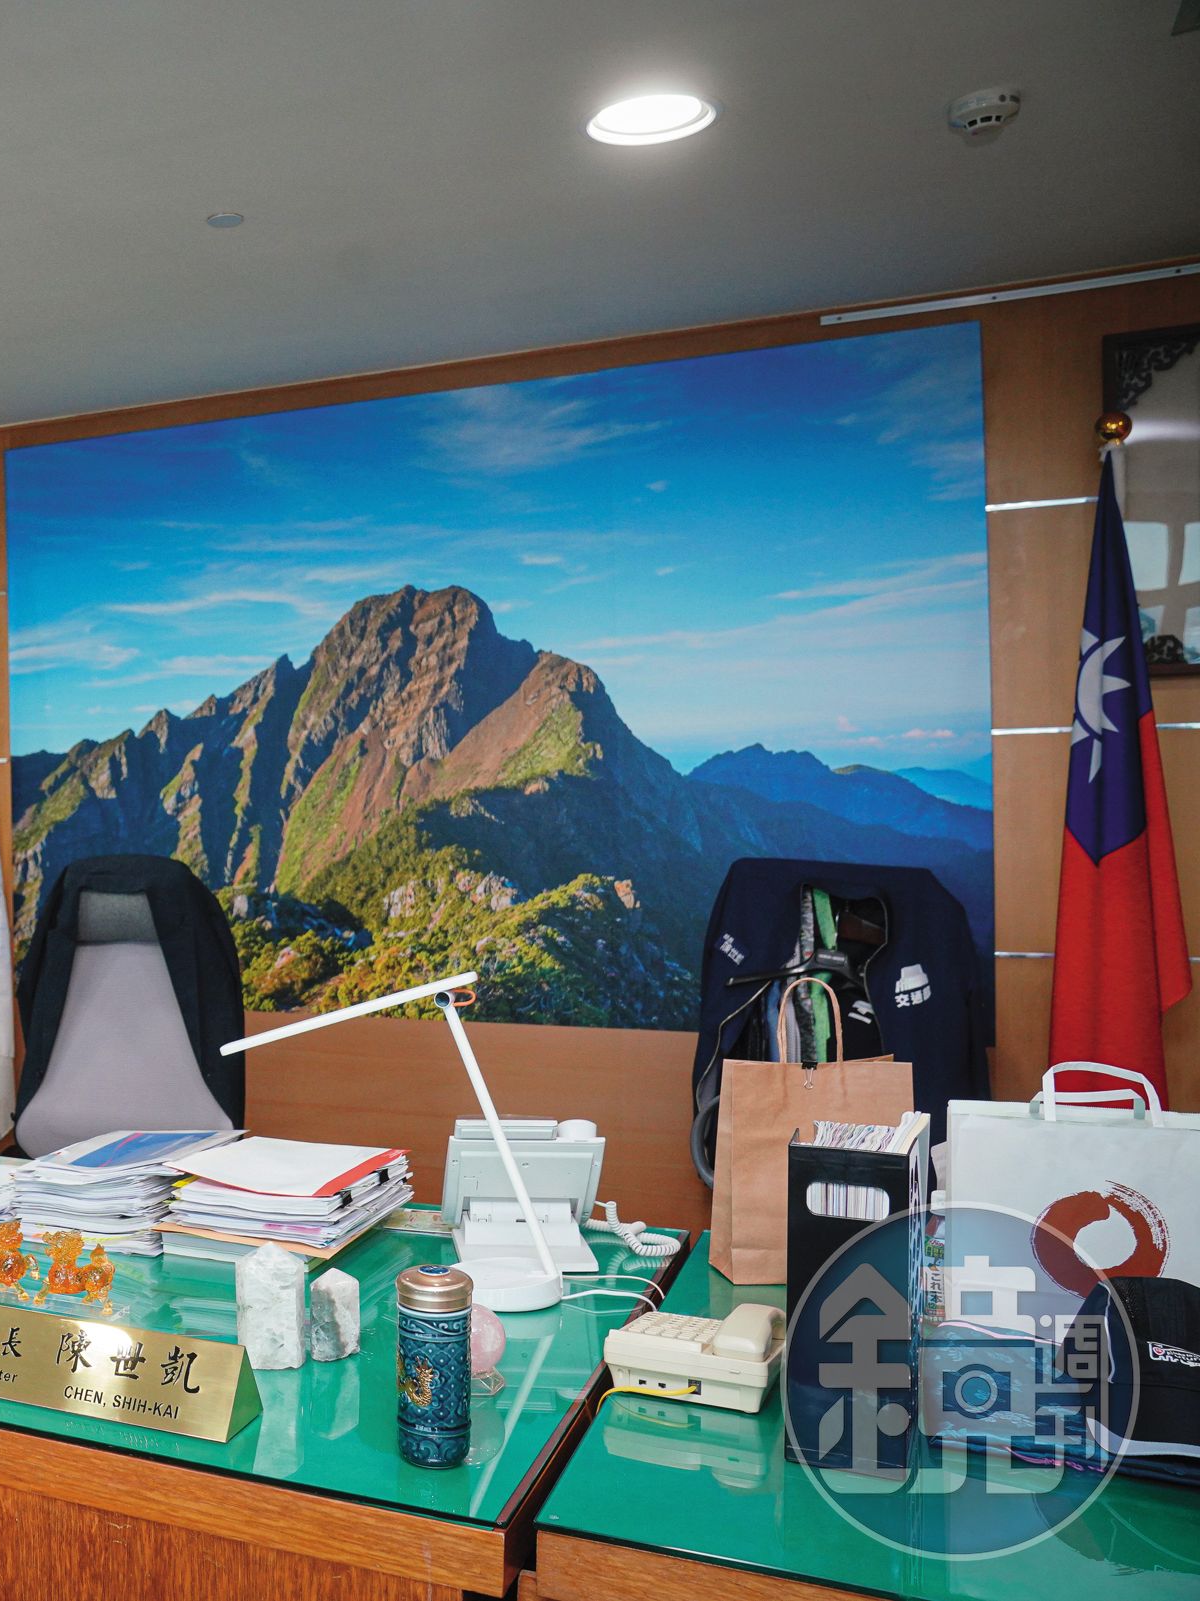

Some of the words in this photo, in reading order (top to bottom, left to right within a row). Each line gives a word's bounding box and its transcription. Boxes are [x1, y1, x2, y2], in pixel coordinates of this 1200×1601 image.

[55, 1330, 201, 1394] 陳世凱
[64, 1384, 107, 1408] CHEN,
[112, 1394, 179, 1420] SHIH-KAI
